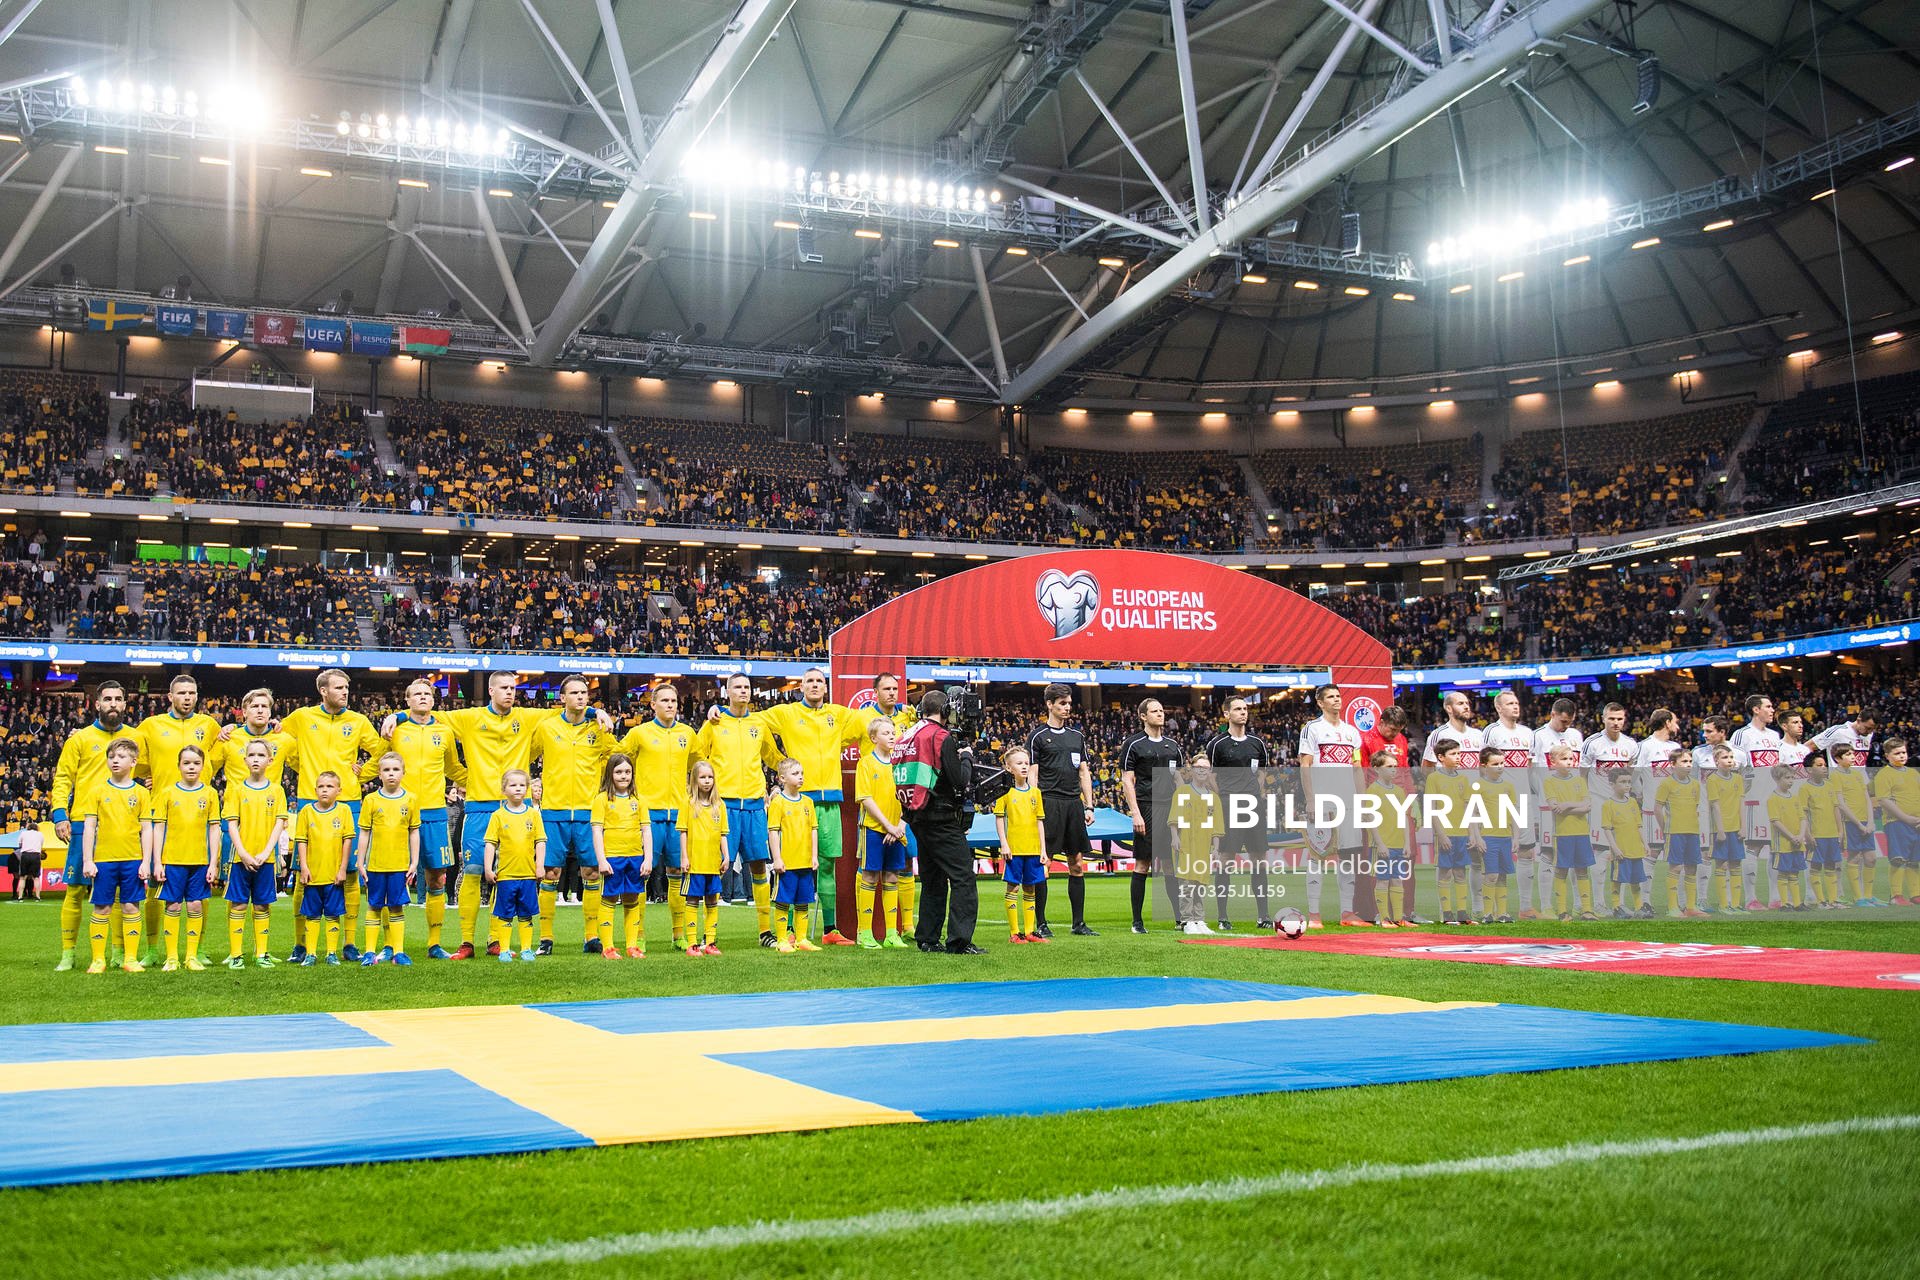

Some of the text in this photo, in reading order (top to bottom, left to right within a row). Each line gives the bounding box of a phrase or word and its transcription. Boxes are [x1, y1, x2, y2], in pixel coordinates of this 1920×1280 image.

[162, 311, 191, 323] FIFA
[307, 328, 343, 342] UEFA
[362, 335, 392, 345] RESPECT
[1112, 588, 1204, 608] EUROPEAN
[1101, 607, 1217, 631] QUALIFIERS
[856, 692, 878, 703] UEF
[1351, 698, 1375, 711] UEFA
[1510, 737, 1520, 748] 19
[1762, 738, 1771, 748] 13
[1384, 744, 1399, 755] 22
[1612, 748, 1618, 758] 4
[1543, 831, 1551, 843] 6
[1754, 825, 1767, 838] 13
